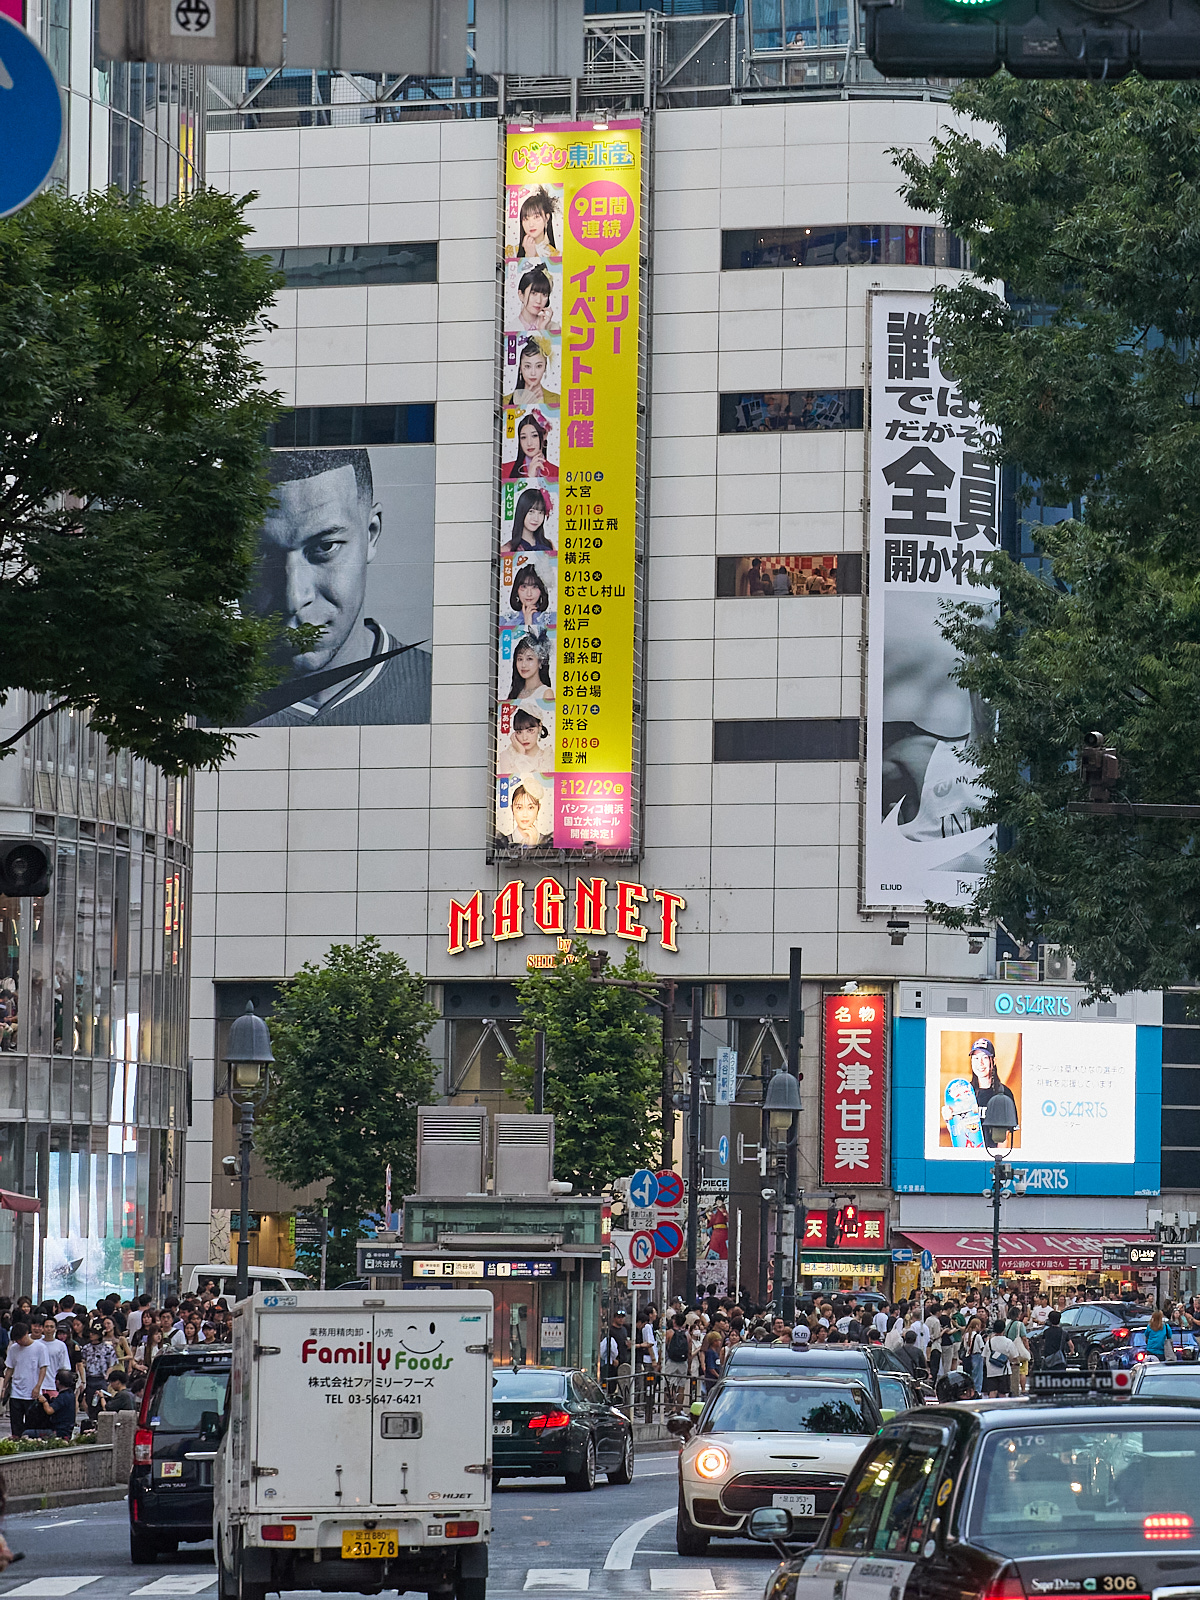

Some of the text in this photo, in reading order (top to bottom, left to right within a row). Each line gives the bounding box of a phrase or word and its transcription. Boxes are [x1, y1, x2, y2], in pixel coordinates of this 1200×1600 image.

[509, 190, 518, 216] かれん
[574, 196, 628, 217] 9日間
[581, 219, 622, 239] 連続
[605, 264, 631, 354] フリー
[508, 339, 516, 360] りね
[566, 264, 597, 449] イベント開催
[507, 413, 515, 433] わか
[565, 485, 592, 498] 大宮
[881, 445, 998, 547] 全員
[505, 484, 514, 517] しんじゅ
[565, 518, 619, 531] 立川立飛
[564, 551, 591, 565] 横浜
[504, 558, 512, 583] ひなの
[564, 584, 626, 597] むさし村山
[563, 618, 590, 631] 松戸
[503, 634, 511, 655] みう
[563, 652, 603, 665] 錦糸町
[562, 685, 602, 698] お台場
[561, 718, 588, 731] 渋谷
[561, 751, 587, 764] 豊洲
[500, 783, 508, 803] ゆな
[560, 803, 624, 815] パシフィコ横浜
[563, 816, 621, 827] 国立大ホール
[570, 828, 615, 840] 開催決定!
[880, 883, 903, 891] ELIUD
[447, 876, 686, 955] MAGNET
[557, 936, 572, 953] by
[834, 1005, 876, 1023] 名物
[834, 1028, 874, 1170] 天津甘栗
[702, 1179, 728, 1187] PIECE
[374, 1260, 398, 1269] 渋谷駅
[501, 1265, 506, 1274] 1
[941, 1259, 988, 1270] SANZENRI
[1001, 1260, 1064, 1268] ハチ公前のくすり屋さん
[302, 1339, 454, 1371] Family Foods
[308, 1376, 435, 1388] 株式会社ファミリーフーズ
[325, 1394, 422, 1405] TEL 03-5647-6421
[799, 1503, 813, 1515] 32
[355, 1532, 371, 1540] 足立
[354, 1541, 395, 1556] 30-78
[1031, 1578, 1054, 1592] Super
[1103, 1576, 1137, 1591] 306
